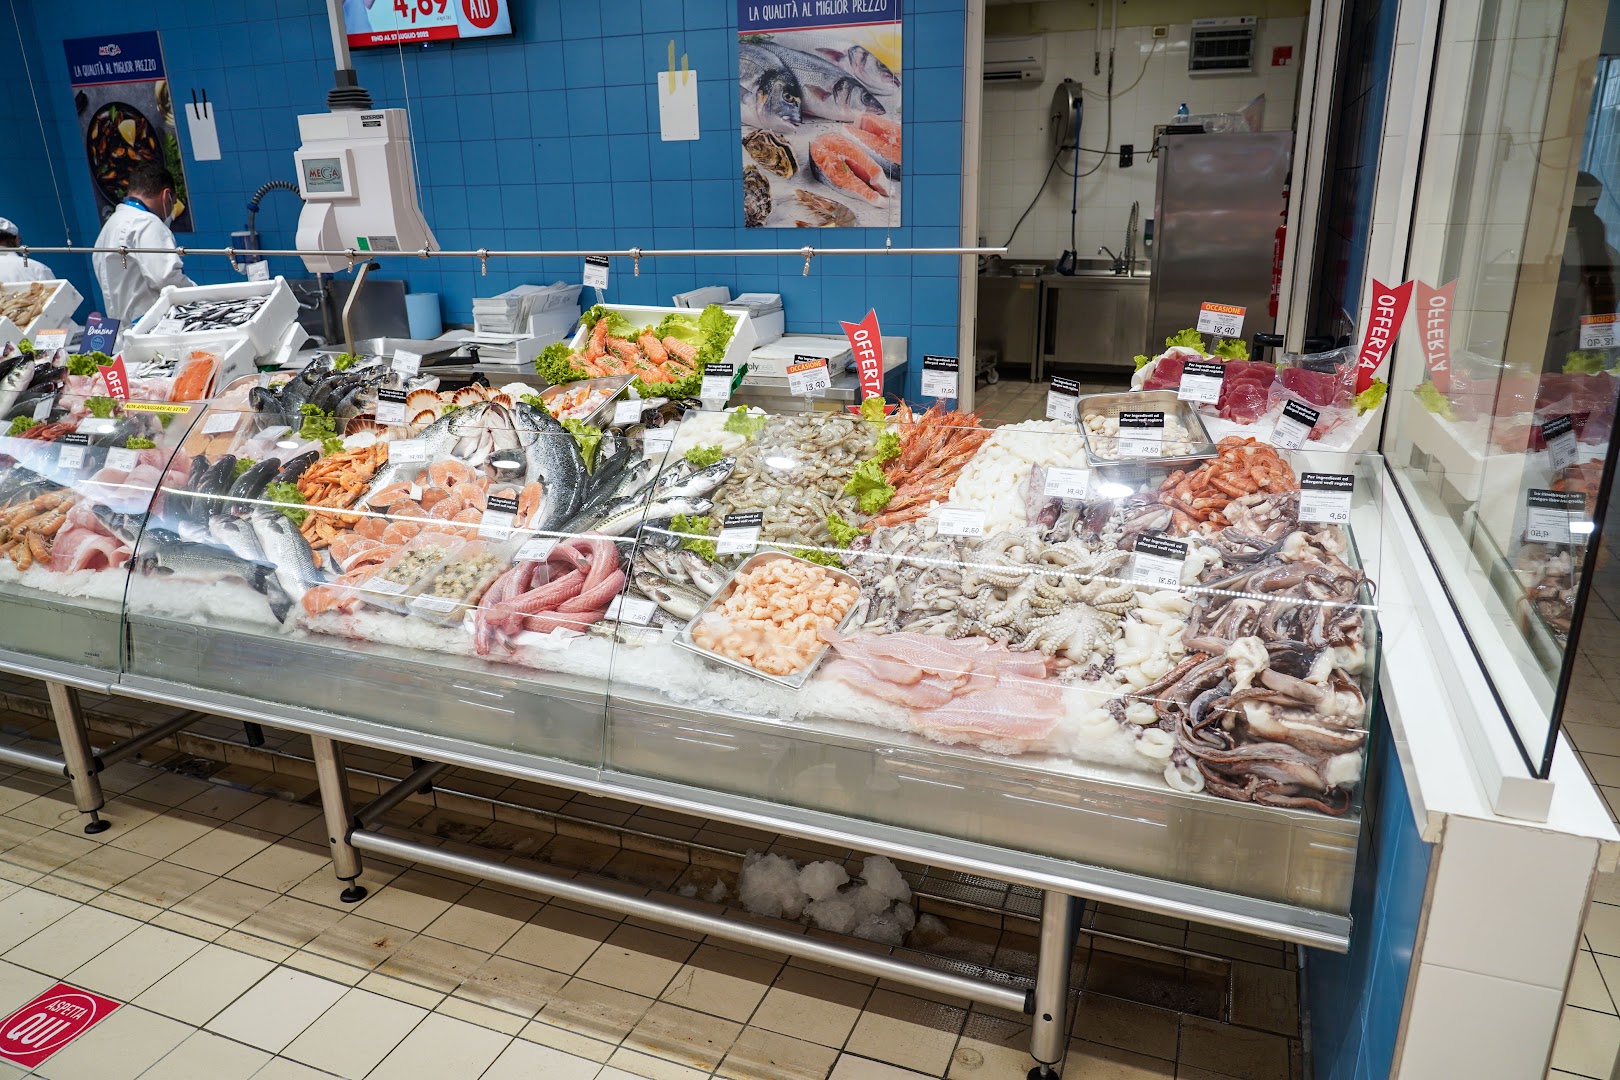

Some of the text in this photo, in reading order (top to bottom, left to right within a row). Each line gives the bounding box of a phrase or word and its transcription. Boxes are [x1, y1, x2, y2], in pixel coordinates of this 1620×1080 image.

[749, 0, 887, 21] LA QUALITÀ AL MIGLIOR PREZZO
[98, 43, 121, 56] MEGA
[74, 58, 157, 77] LA QUALITÀ AL MIGLIOR PREZZO
[309, 166, 340, 181] MEGA
[1205, 303, 1242, 314] OCCASIONE
[1359, 294, 1397, 369] OFFERTA
[790, 360, 822, 373] OCCASIONE
[853, 330, 880, 400] OFFERTA
[44, 999, 88, 1021] ASPETTA
[6, 1012, 72, 1049] QUI
